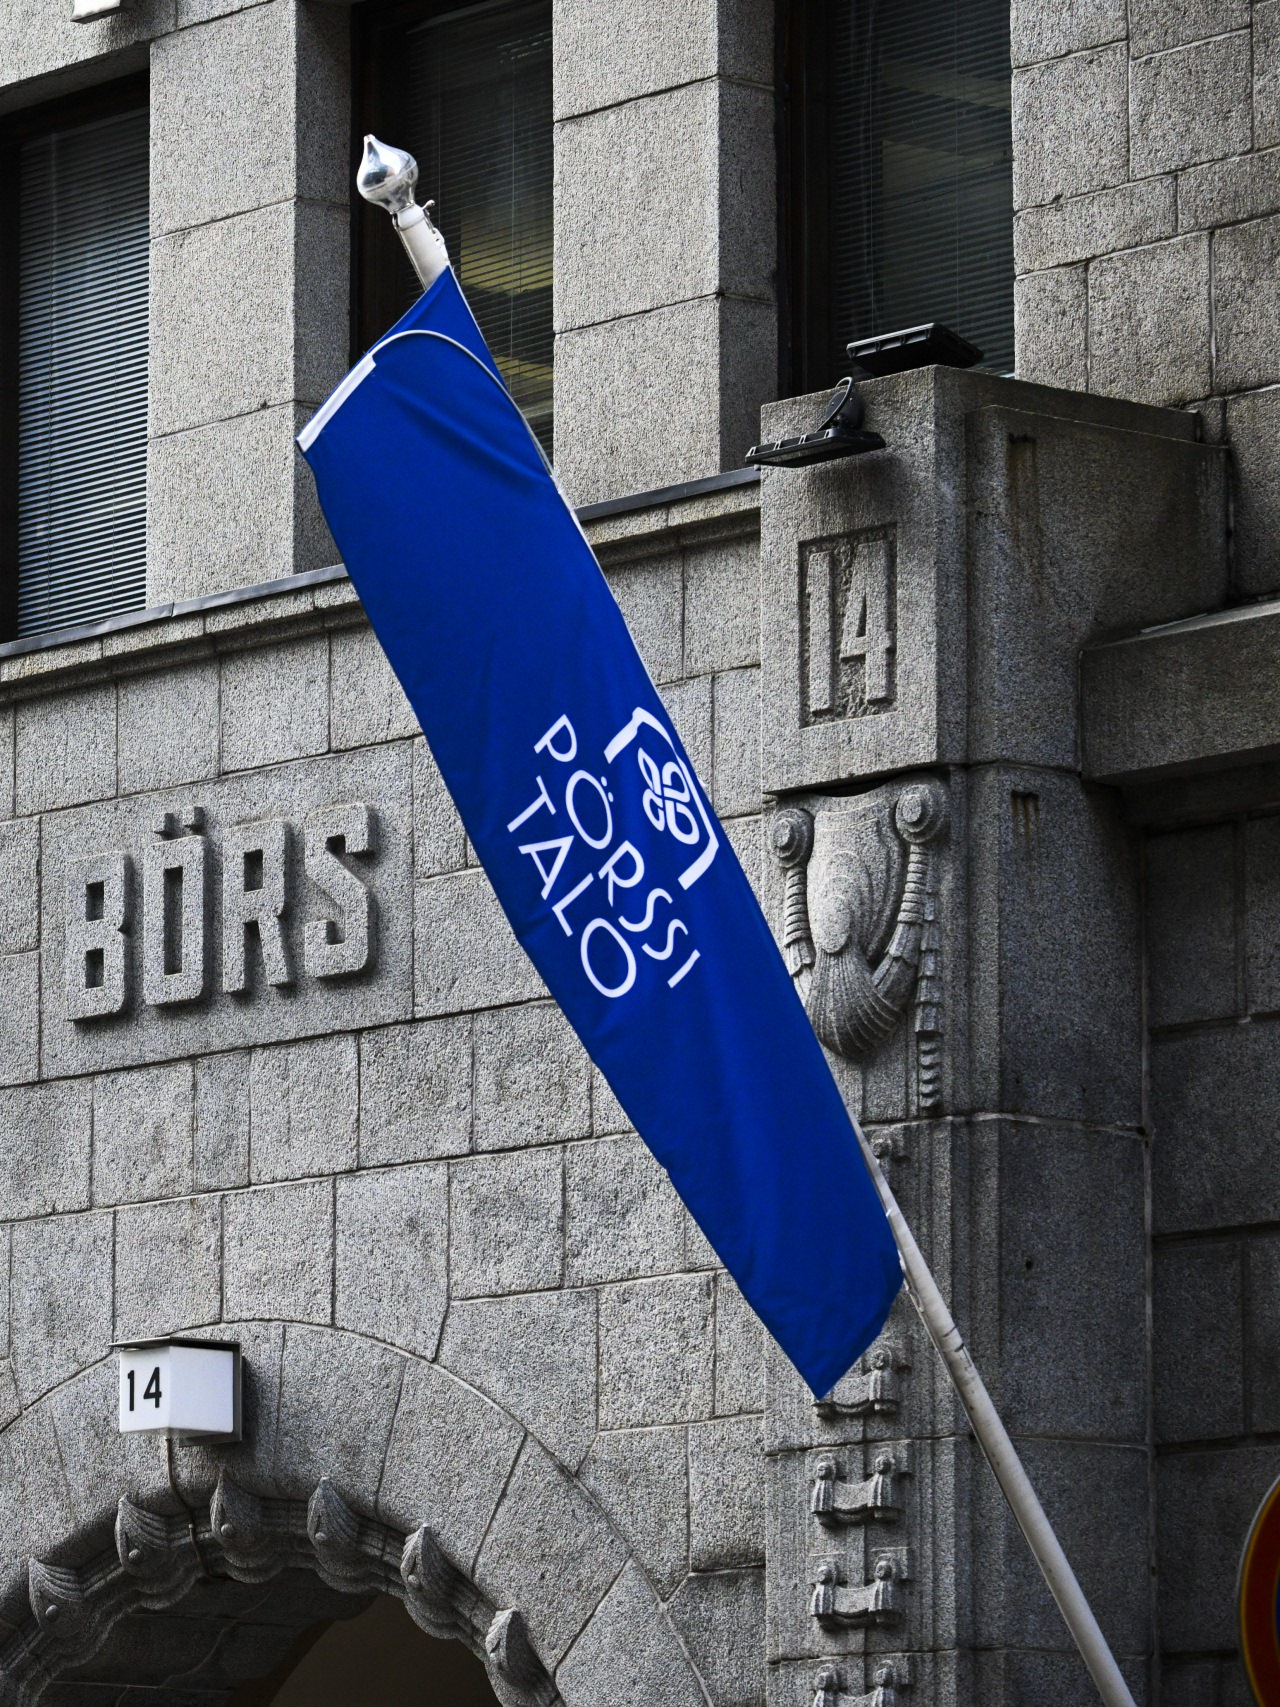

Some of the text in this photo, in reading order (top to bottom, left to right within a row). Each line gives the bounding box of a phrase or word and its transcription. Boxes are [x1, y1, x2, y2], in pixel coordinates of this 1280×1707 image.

[806, 539, 892, 711] 14
[66, 802, 374, 1022] BÖRS
[506, 775, 637, 999] TALO
[533, 713, 701, 989] PÖRSSI
[127, 1366, 163, 1412] 14
